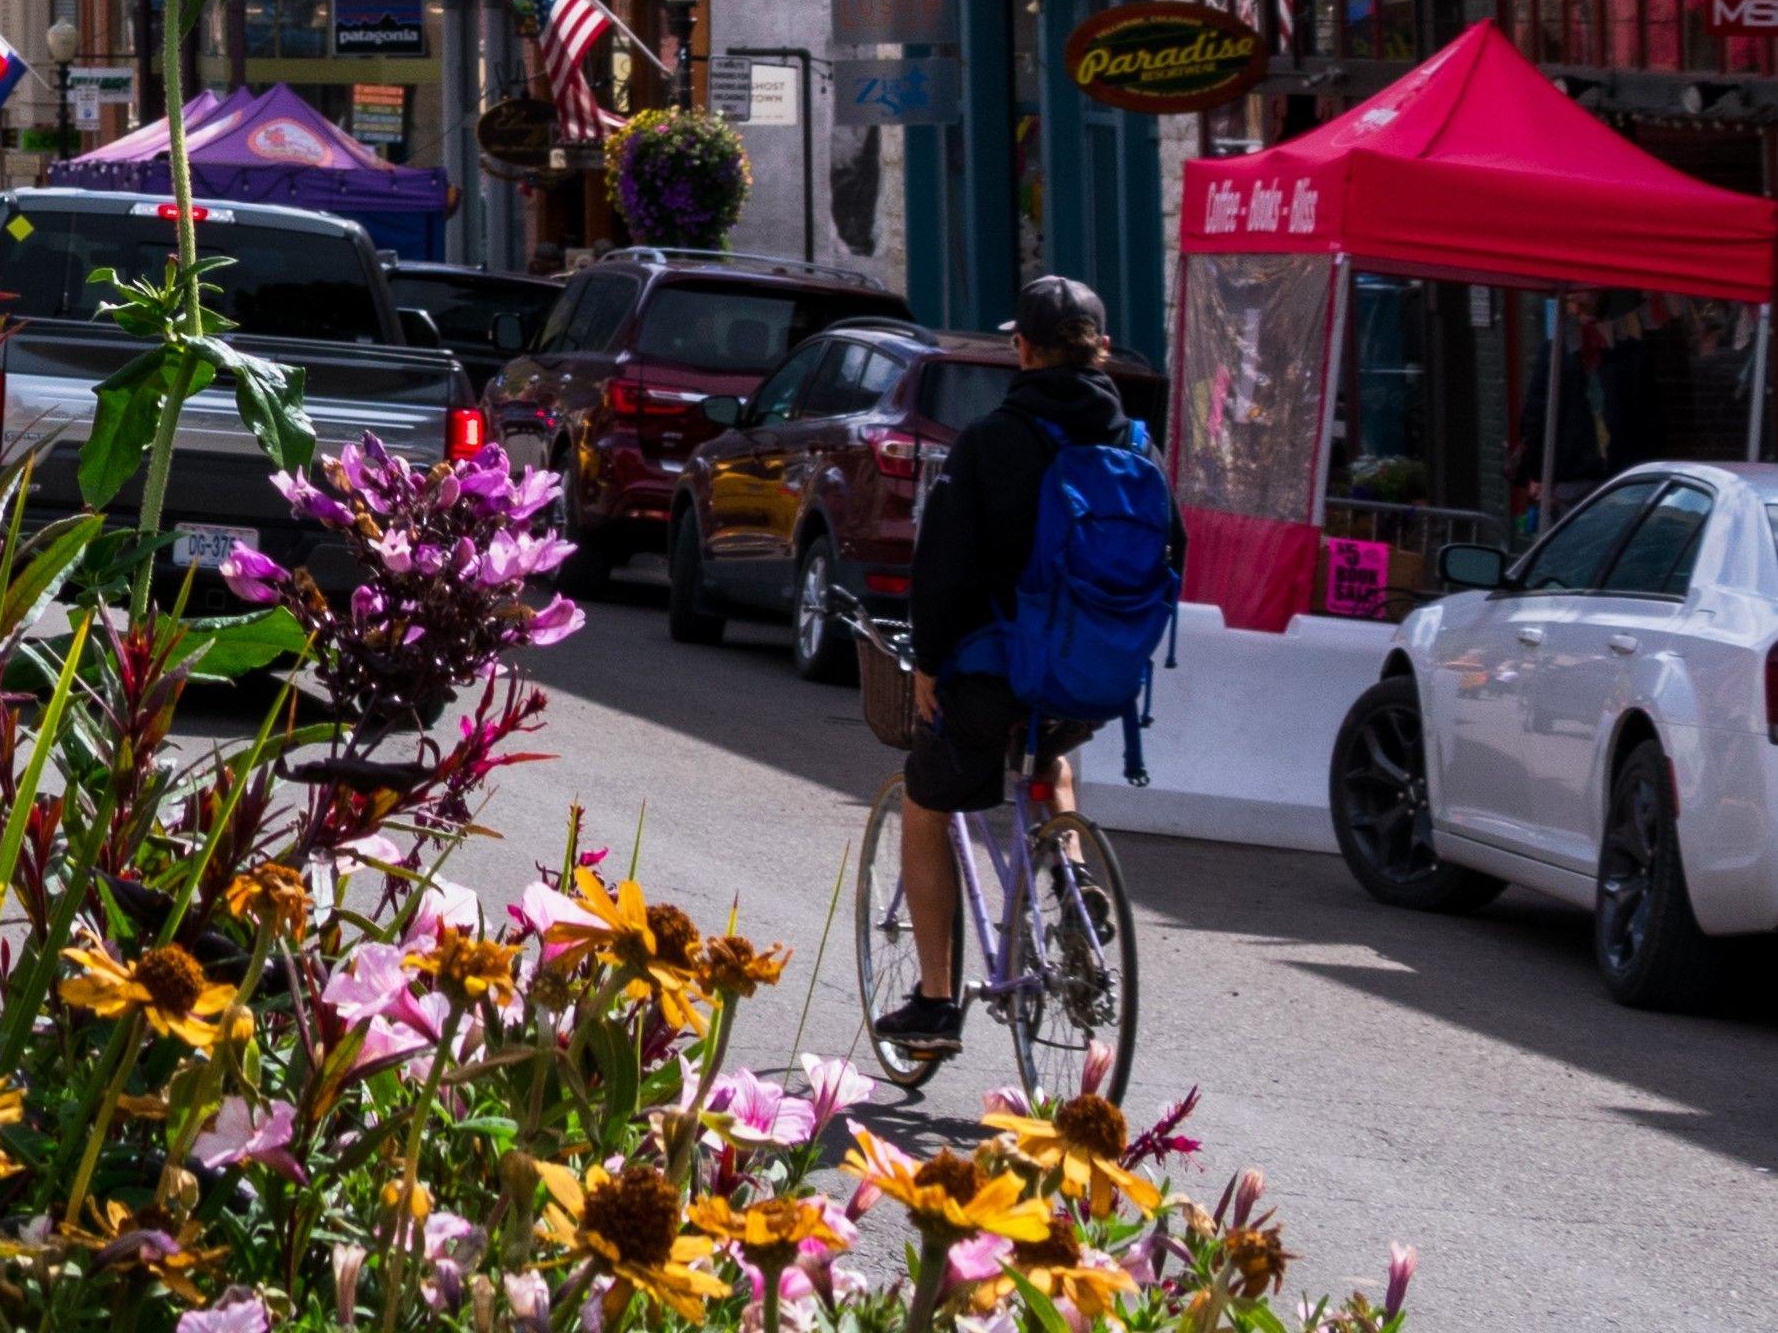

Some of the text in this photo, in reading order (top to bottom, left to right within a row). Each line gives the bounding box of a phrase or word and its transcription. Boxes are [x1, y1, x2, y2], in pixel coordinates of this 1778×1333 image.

[339, 29, 419, 44] patagonia
[1076, 29, 1256, 85] Paradise
[754, 82, 785, 91] HOST
[1205, 177, 1318, 233] Coffee Books Bliss
[1336, 566, 1378, 585] BOOK
